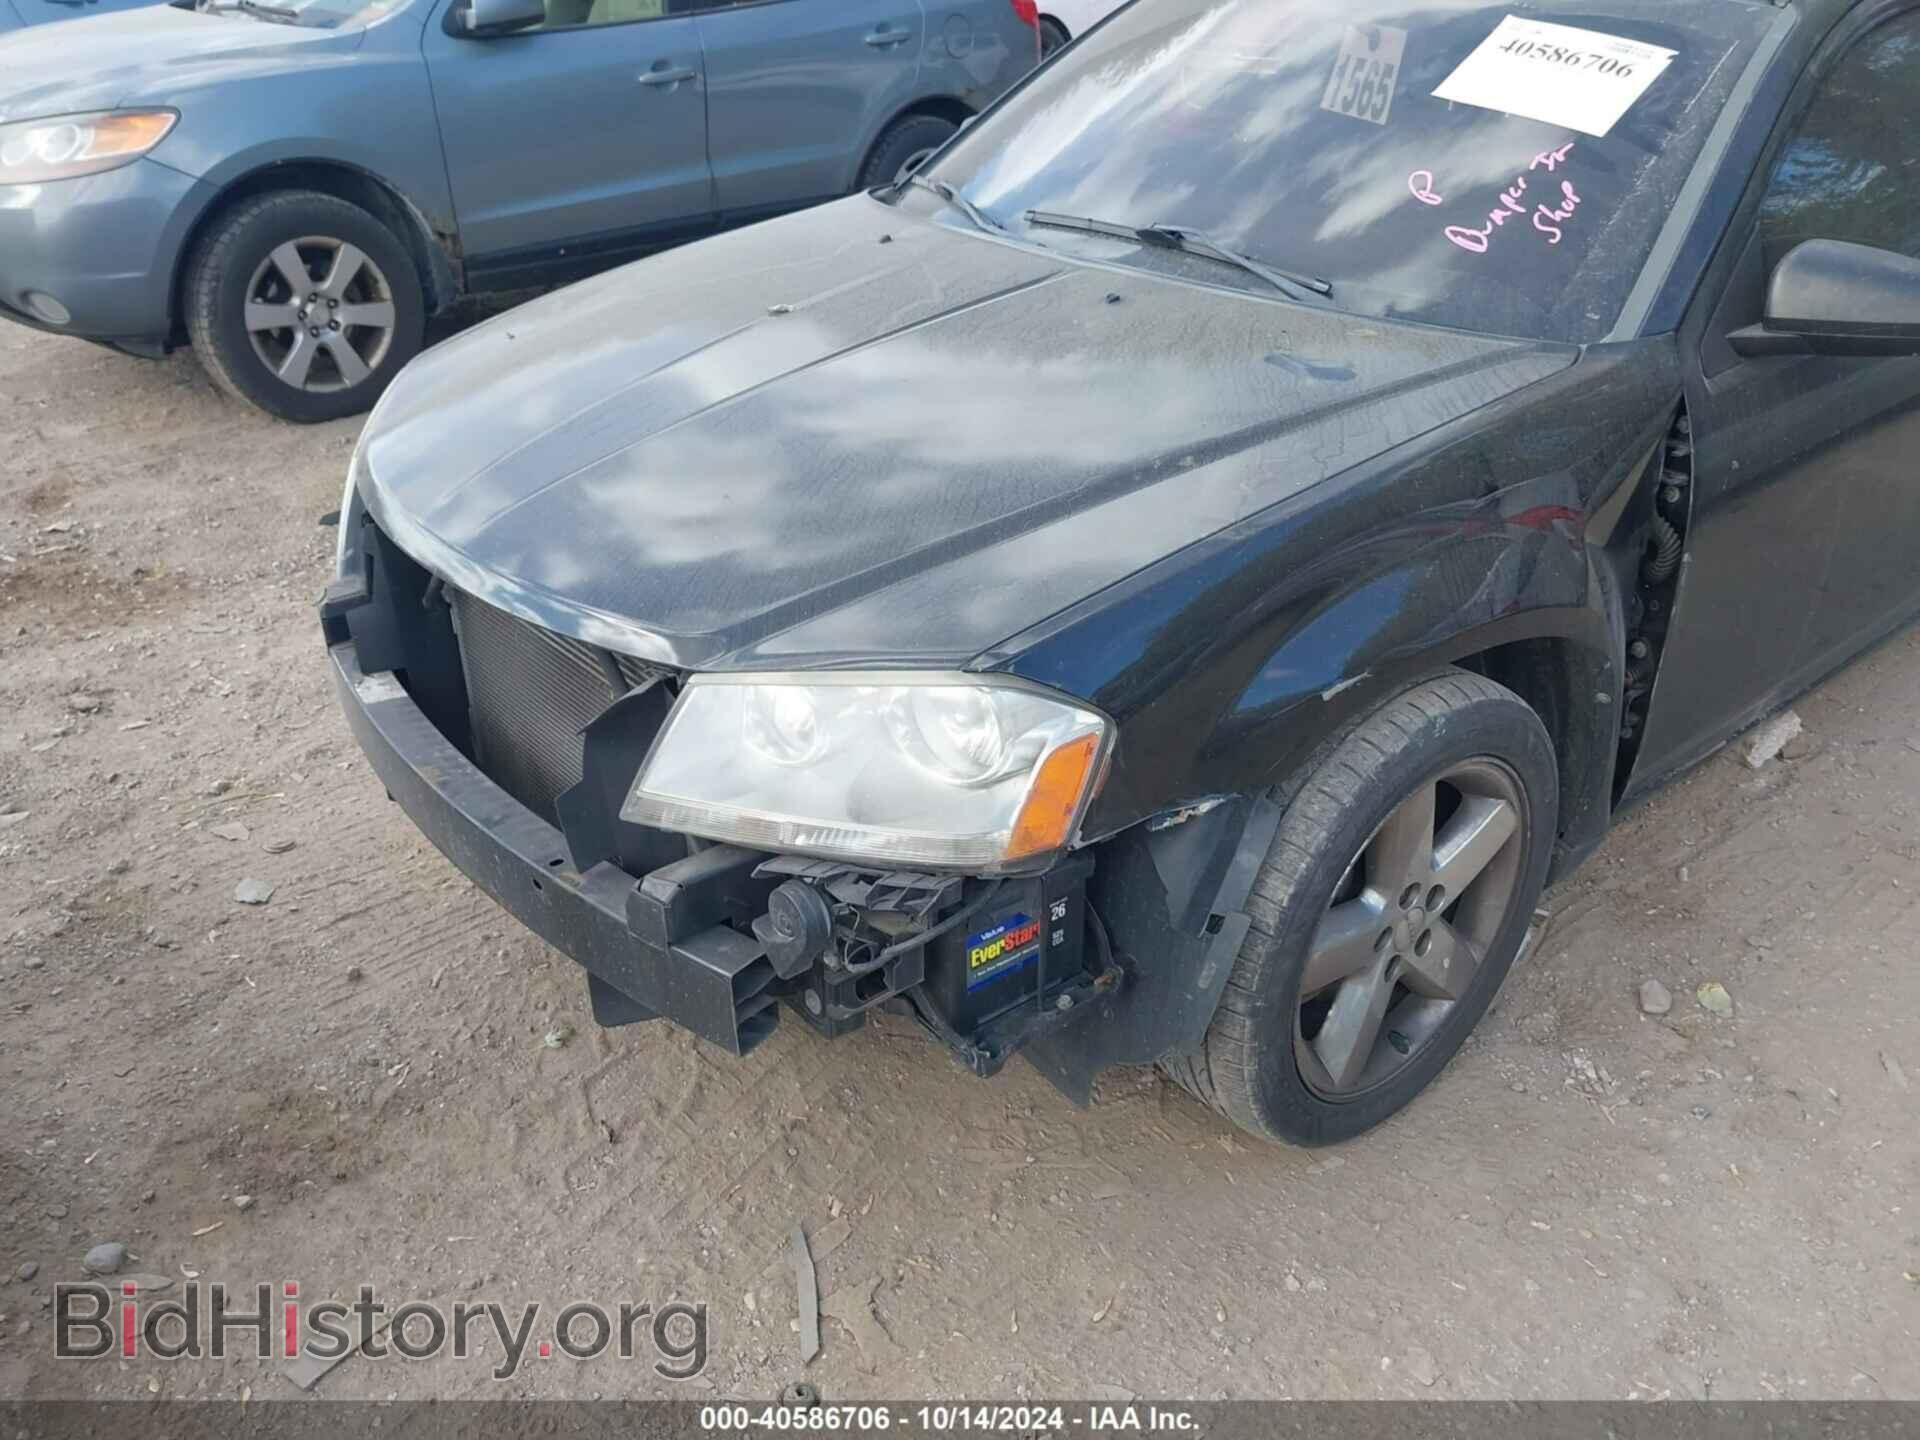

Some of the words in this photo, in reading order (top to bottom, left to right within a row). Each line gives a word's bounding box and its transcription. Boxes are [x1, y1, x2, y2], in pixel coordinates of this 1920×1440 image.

[1500, 38, 1634, 79] 40586706
[1328, 54, 1394, 120] 1565
[1051, 903, 1066, 921] 26
